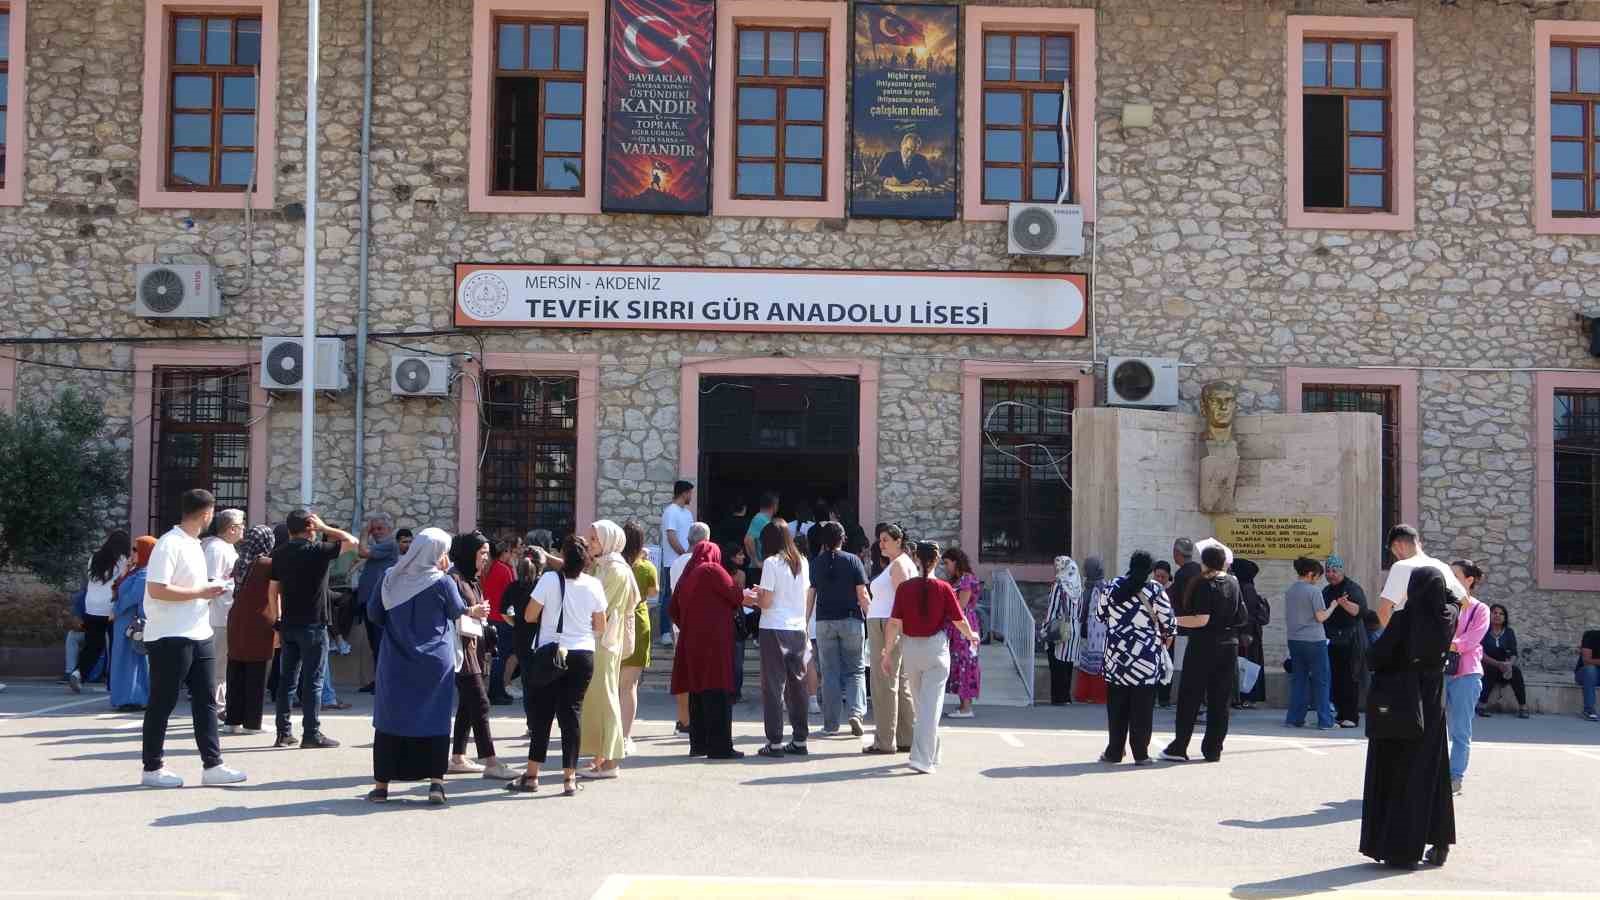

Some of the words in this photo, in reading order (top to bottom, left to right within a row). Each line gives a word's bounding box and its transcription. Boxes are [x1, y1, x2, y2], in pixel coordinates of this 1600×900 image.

[628, 72, 692, 83] BAYRAKLARI
[620, 98, 697, 114] KANDIR
[870, 104, 908, 118] çalışkan
[621, 142, 696, 157] VATANDIR
[525, 274, 582, 289] MERSİN
[595, 275, 661, 290] AKDENİZ
[525, 296, 620, 319] TEVFİK
[627, 300, 694, 320] SIRRI
[702, 297, 760, 321] GÜR
[766, 302, 902, 323] ANADOLU
[910, 301, 988, 325] LİSESİ
